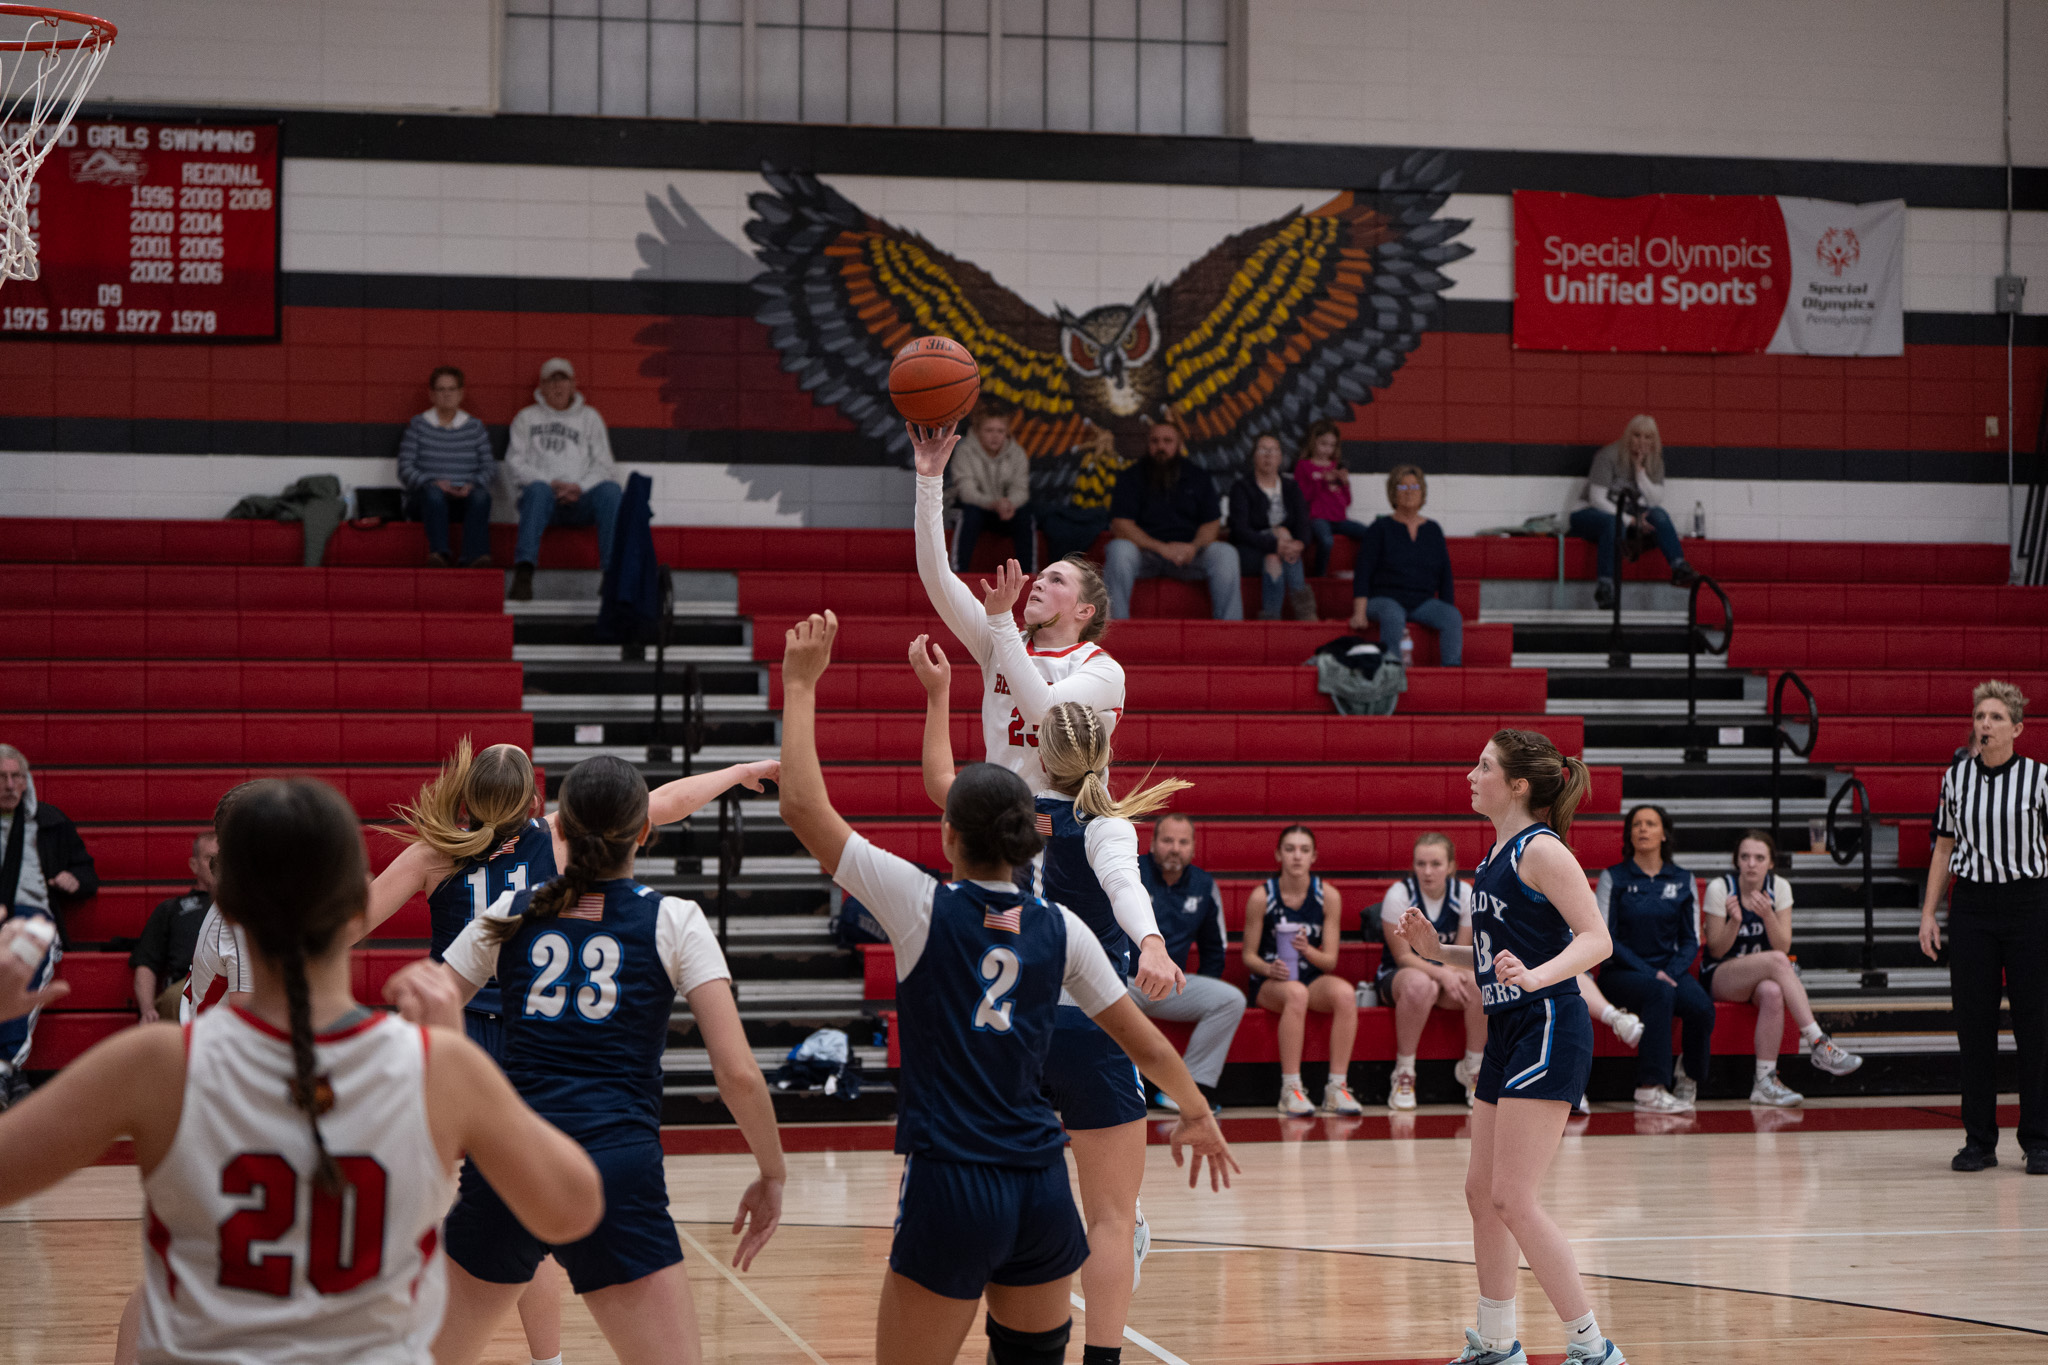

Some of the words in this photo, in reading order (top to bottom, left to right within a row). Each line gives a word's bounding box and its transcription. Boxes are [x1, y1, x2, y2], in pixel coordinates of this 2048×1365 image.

[0, 121, 79, 148] DFORD
[86, 125, 150, 149] GIRLS
[158, 127, 256, 154] SWIMMING
[181, 161, 264, 186] REGIONAL
[130, 185, 175, 209] 1996
[179, 186, 224, 210] 2003
[129, 210, 175, 235] 2000
[179, 211, 224, 235] 2004
[129, 235, 174, 259] 2001
[179, 236, 225, 260] 2005
[1543, 235, 1641, 273] Special
[1645, 235, 1772, 274] Olympics
[129, 259, 175, 284] 2002
[179, 261, 224, 285] 2006
[1544, 272, 1654, 305] Unified
[1808, 281, 1868, 296] Special
[1801, 296, 1876, 312] Olympics
[2, 307, 49, 331] 1975
[59, 308, 105, 332] 1976
[115, 308, 162, 333] 1977
[170, 310, 217, 334] 1978
[1470, 890, 1509, 923] ADY
[521, 930, 624, 1023] 23
[970, 943, 1023, 1035] 2
[216, 1152, 389, 1299] 20
